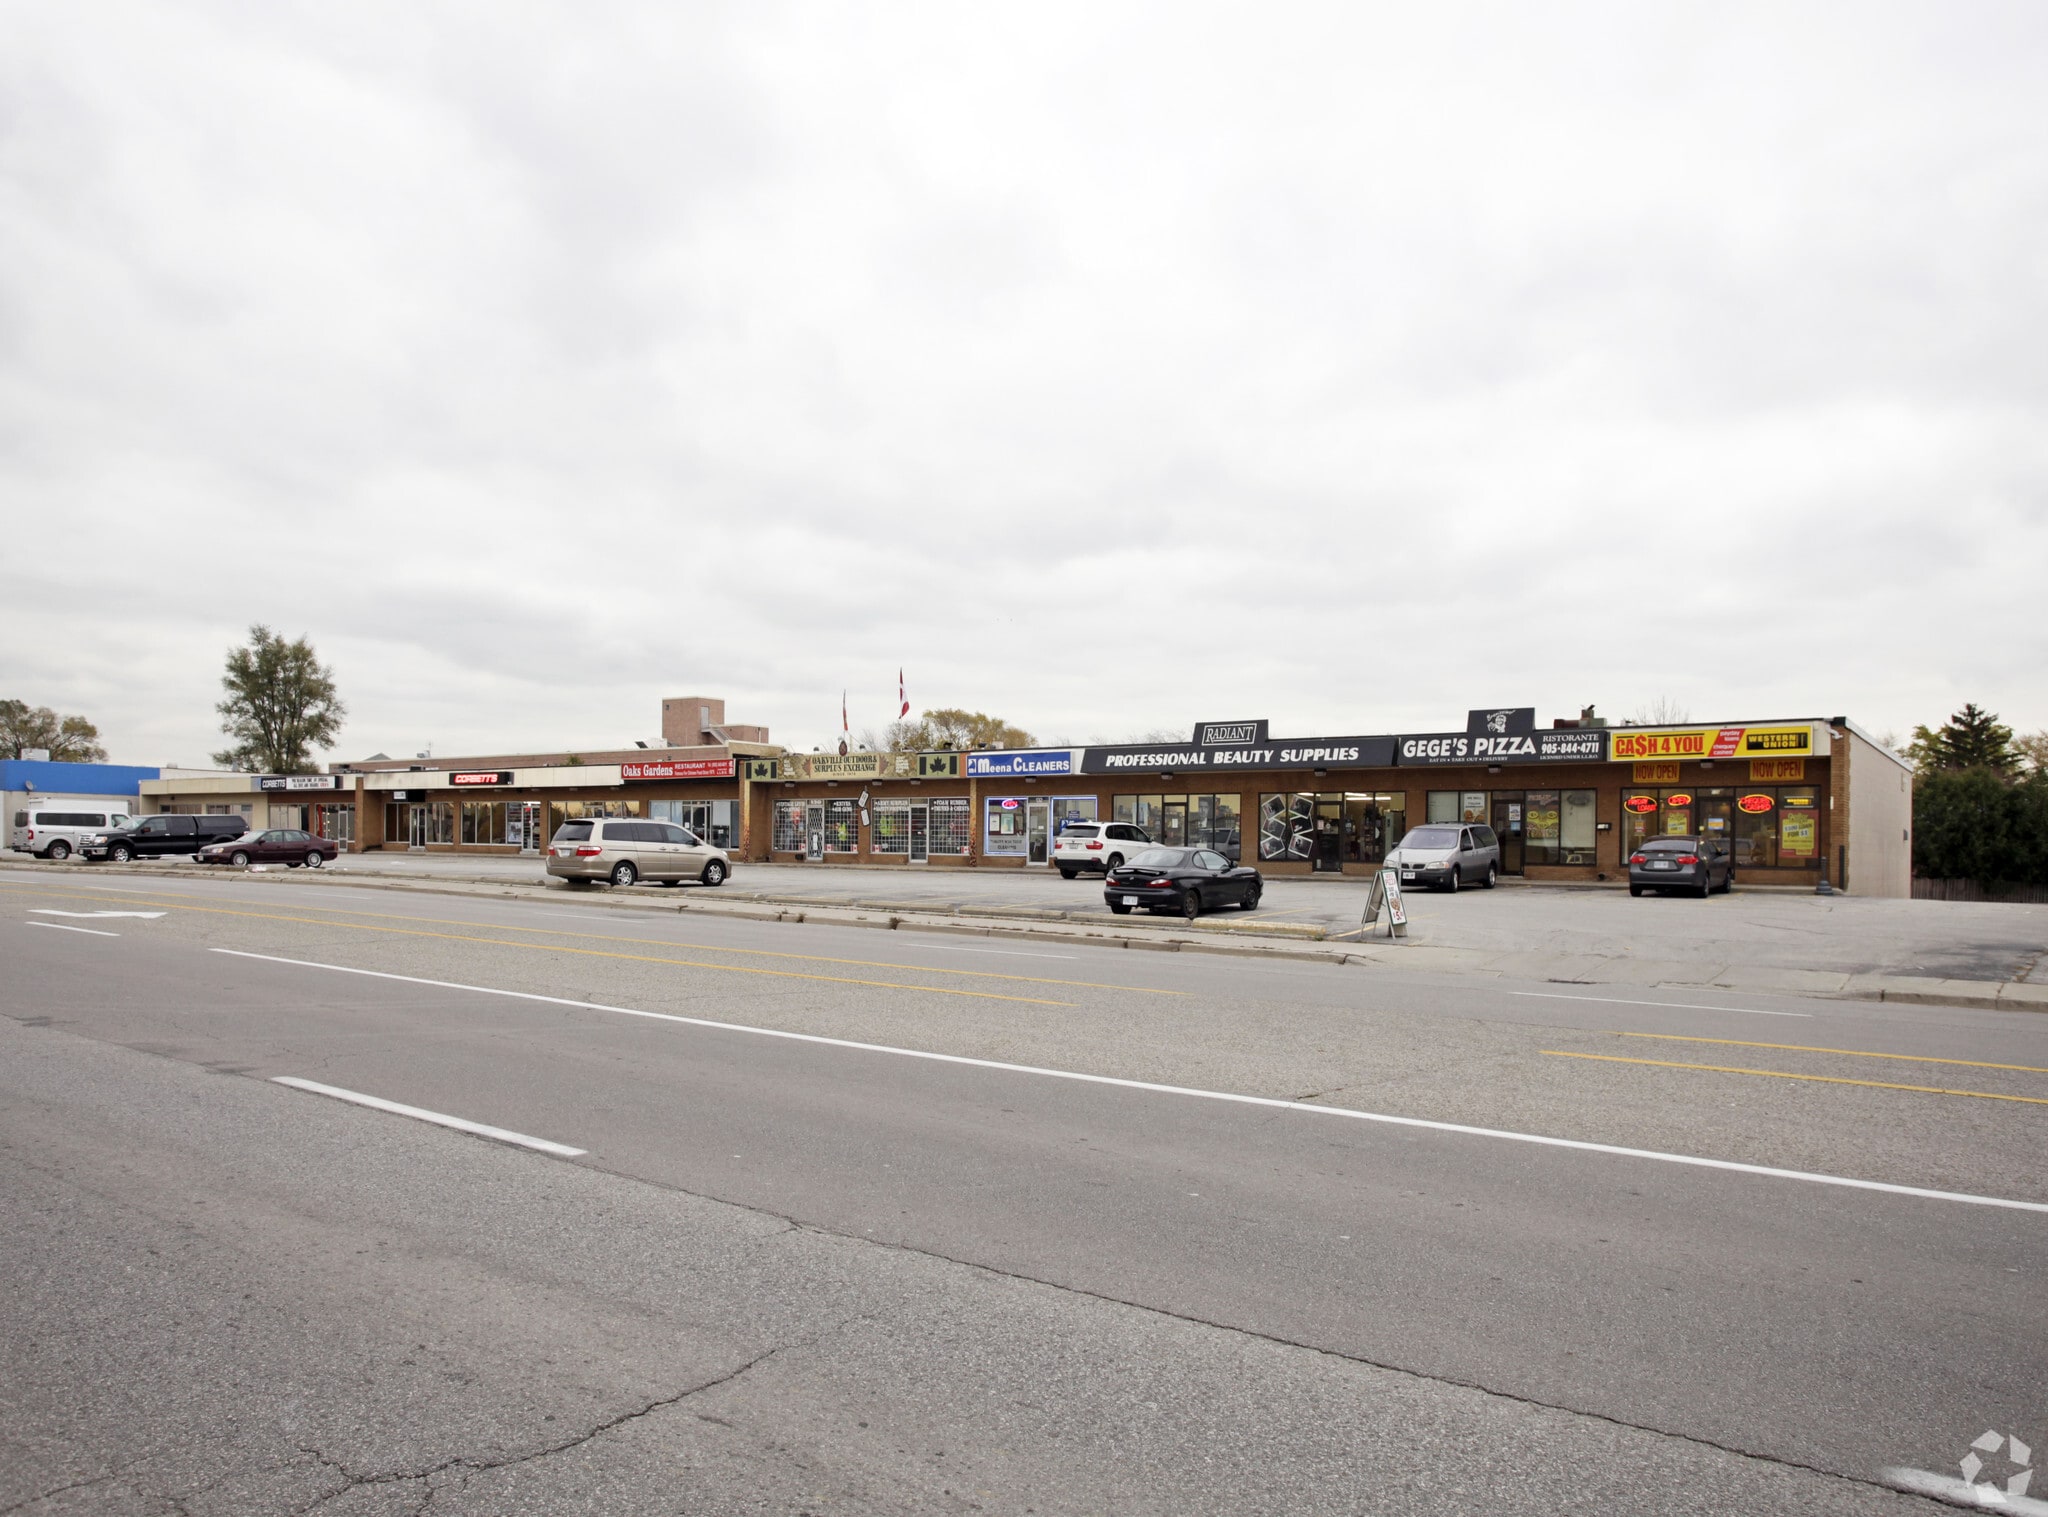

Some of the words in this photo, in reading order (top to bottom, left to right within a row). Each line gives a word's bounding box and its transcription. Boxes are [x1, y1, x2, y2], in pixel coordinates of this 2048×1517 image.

[1205, 726, 1254, 743] RADIANT
[1542, 734, 1599, 742] RISTORANTE
[1748, 735, 1796, 743] WESTERN
[1403, 738, 1468, 757] GEGE'S
[1473, 737, 1536, 755] PIZZA
[1615, 734, 1658, 757] CA$H
[1661, 737, 1670, 753] 4
[1673, 736, 1704, 753] YOU
[812, 756, 843, 764] OAKVILLE
[1105, 752, 1206, 767] PROFESSIONAL
[1213, 750, 1274, 764] BEAUTY
[1280, 747, 1359, 762] SUPPLIES
[623, 765, 641, 777] Oaks
[643, 764, 674, 776] Gardens
[814, 764, 842, 772] SURPLUS
[843, 763, 876, 771] EXCHANGE
[978, 758, 1012, 774] Meena
[1013, 757, 1070, 772] CLEANERS
[1635, 765, 1655, 779] NOW
[1656, 765, 1677, 779] OPEN
[1752, 762, 1774, 777] NOW
[1776, 761, 1801, 777] OPEN
